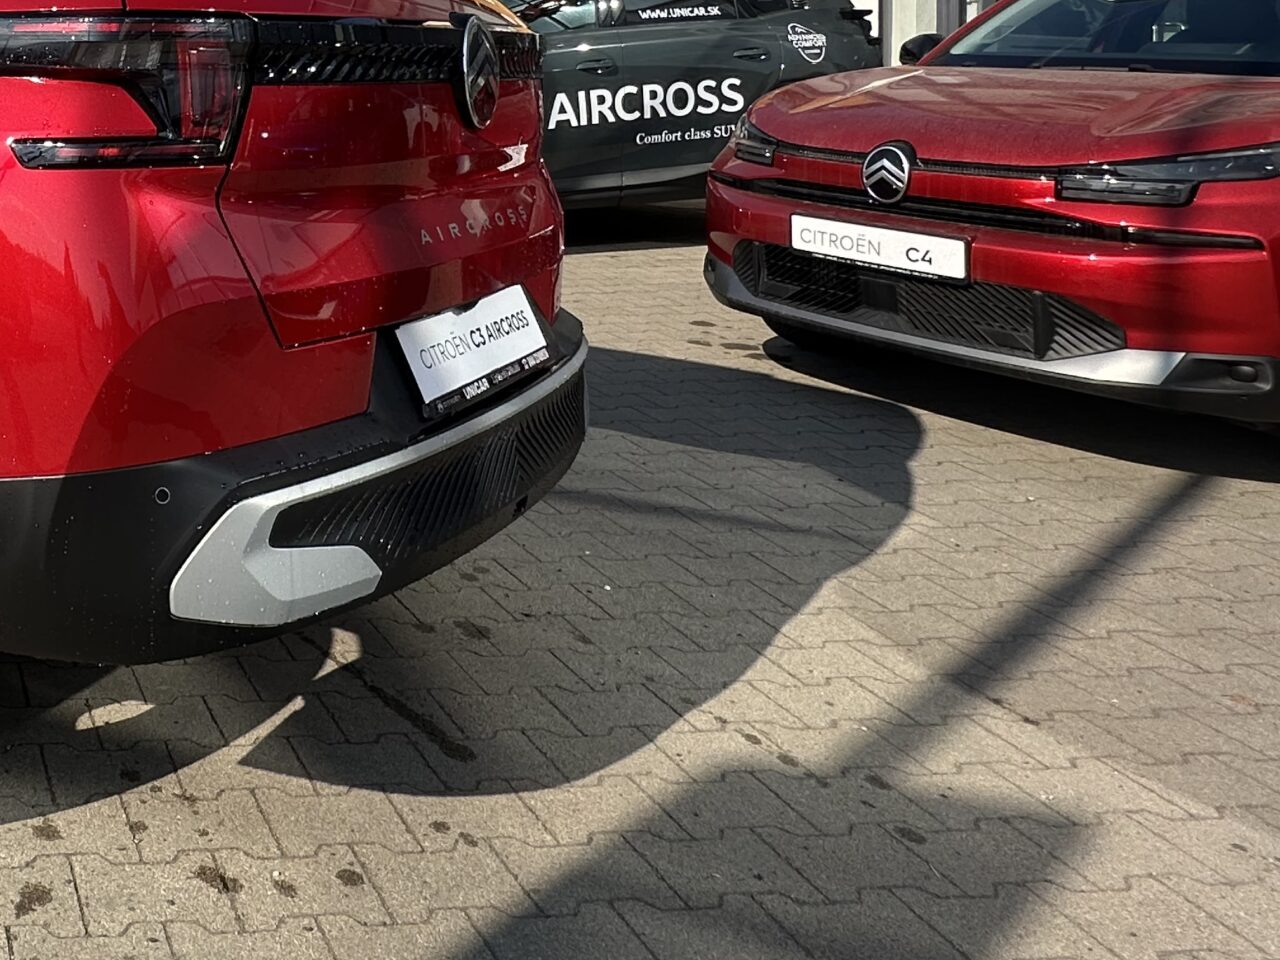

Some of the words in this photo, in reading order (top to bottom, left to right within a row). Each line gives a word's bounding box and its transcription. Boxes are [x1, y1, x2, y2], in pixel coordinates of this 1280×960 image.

[638, 6, 722, 19] WWW.UNICAR.SK
[548, 77, 745, 130] AIRCROSS
[636, 129, 682, 145] Comfort
[684, 127, 711, 141] class
[421, 205, 528, 245] AIRCROSS
[800, 228, 881, 257] CITROËN
[905, 247, 933, 266] C4
[419, 331, 472, 370] CITROËN
[469, 327, 487, 348] C3
[484, 310, 530, 343] AIRCROSS
[462, 377, 490, 400] UNICAR
